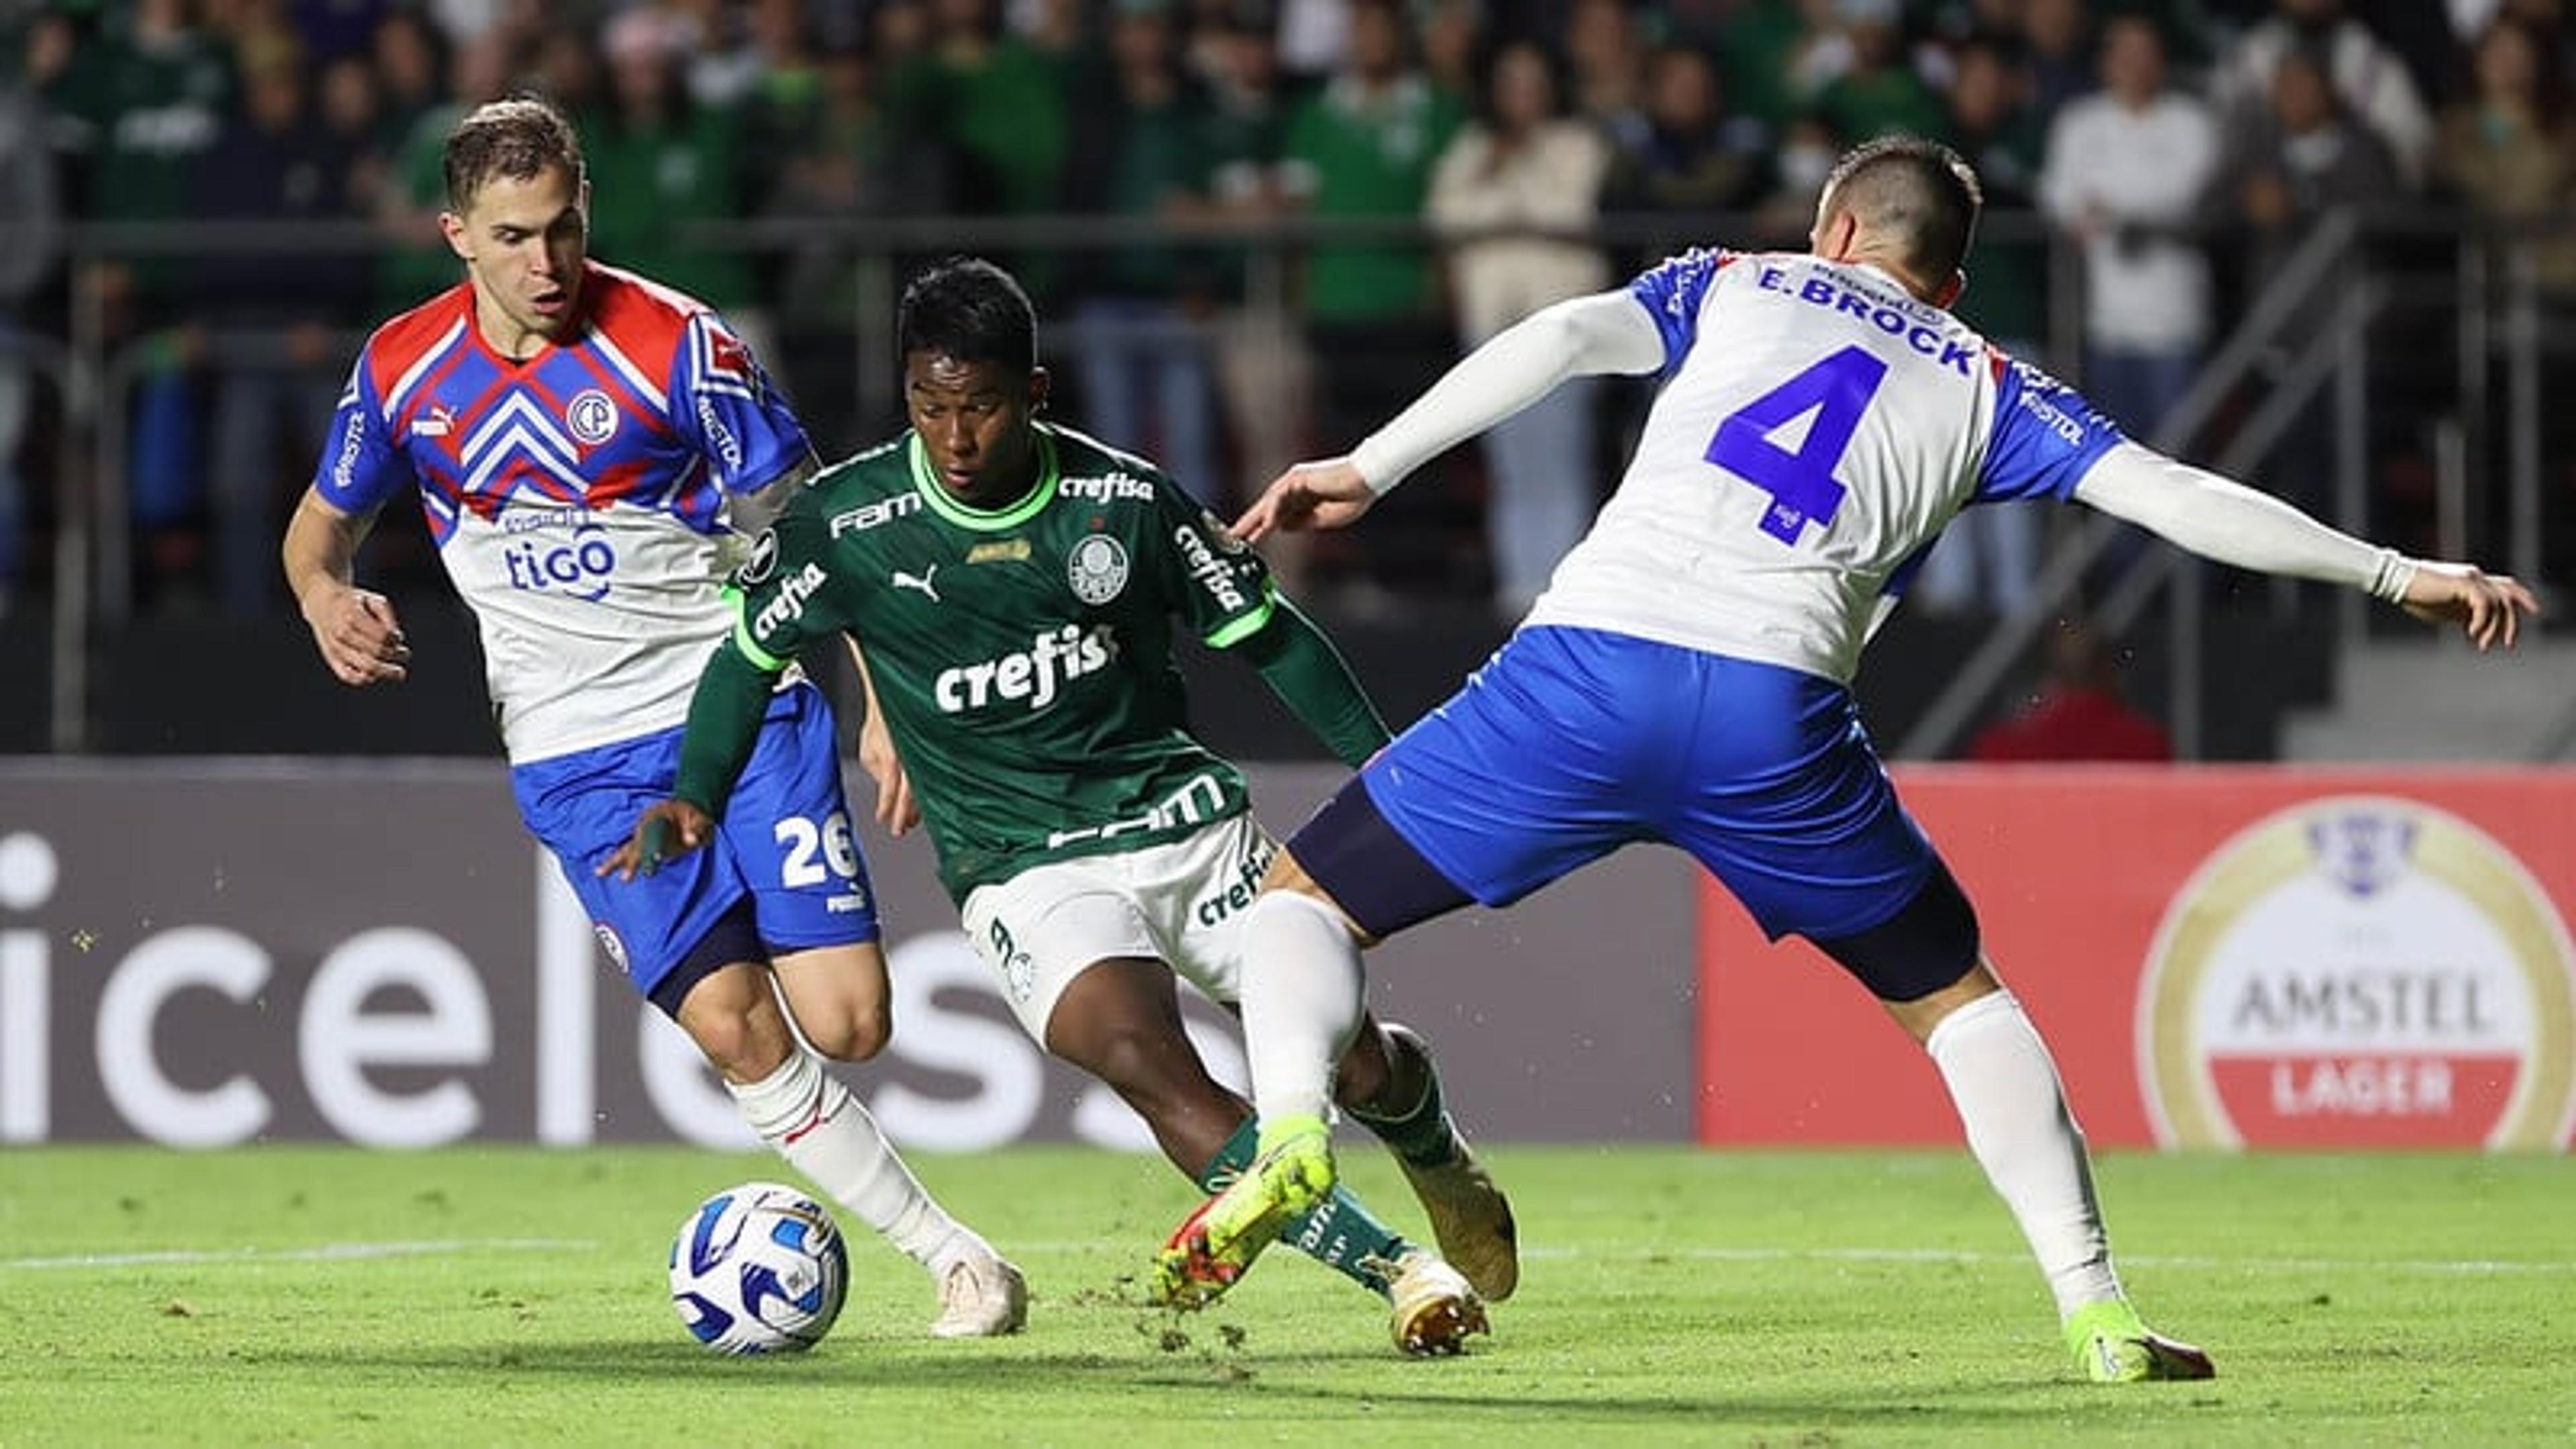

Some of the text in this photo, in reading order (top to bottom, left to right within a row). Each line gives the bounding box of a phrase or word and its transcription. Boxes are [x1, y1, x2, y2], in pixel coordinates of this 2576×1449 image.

[1759, 267, 1978, 376] E.BROCK
[1704, 343, 1889, 548] 4
[1059, 472, 1155, 504] crefisa
[1175, 524, 1245, 612] crefisa
[775, 810, 858, 889] 26
[2234, 974, 2490, 1034] AMSTEL
[2272, 1057, 2455, 1116] LAGER
